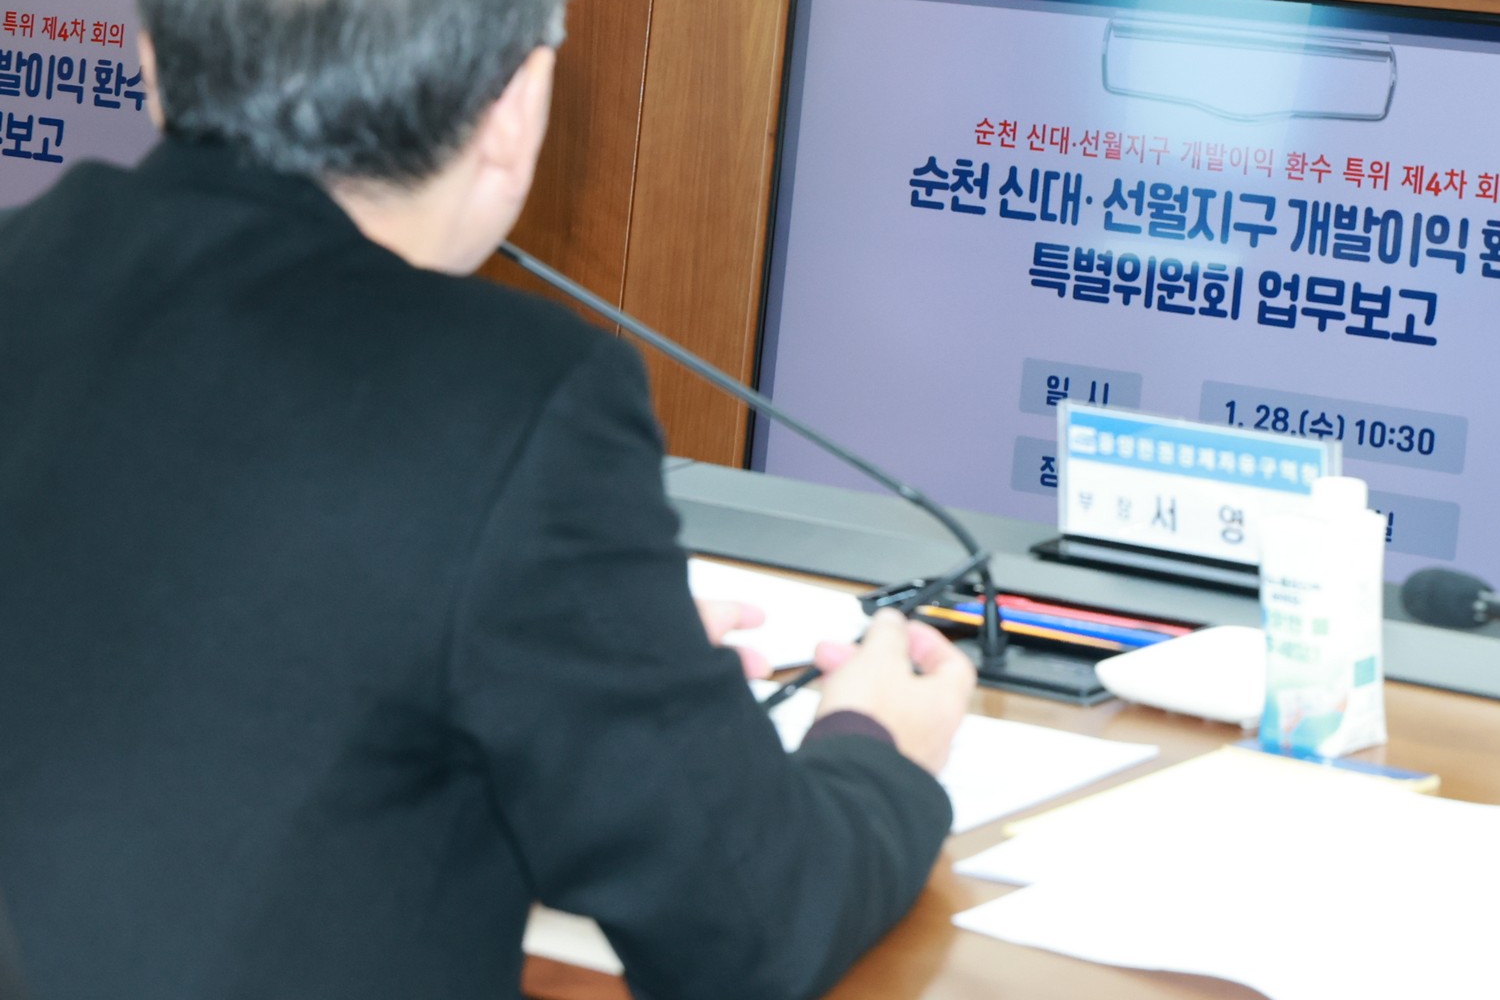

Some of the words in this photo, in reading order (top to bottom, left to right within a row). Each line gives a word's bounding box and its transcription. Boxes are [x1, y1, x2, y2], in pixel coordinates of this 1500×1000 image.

[2, 10, 35, 38] 특위
[41, 15, 86, 44] 제4차
[90, 21, 125, 48] 회의
[0, 111, 65, 163] 보고
[974, 117, 1018, 149] 순천
[1180, 139, 1274, 178] 개발이익
[1284, 152, 1333, 183] 환수
[1342, 157, 1390, 191] 특위
[1401, 164, 1467, 199] 제4차
[909, 155, 990, 215] 순천
[1103, 178, 1278, 248] 선월지구
[1288, 198, 1469, 274] 개발이익
[1028, 241, 1244, 320] 특별위원회
[1257, 270, 1438, 347] 업무보고
[1355, 419, 1436, 455] 10:30
